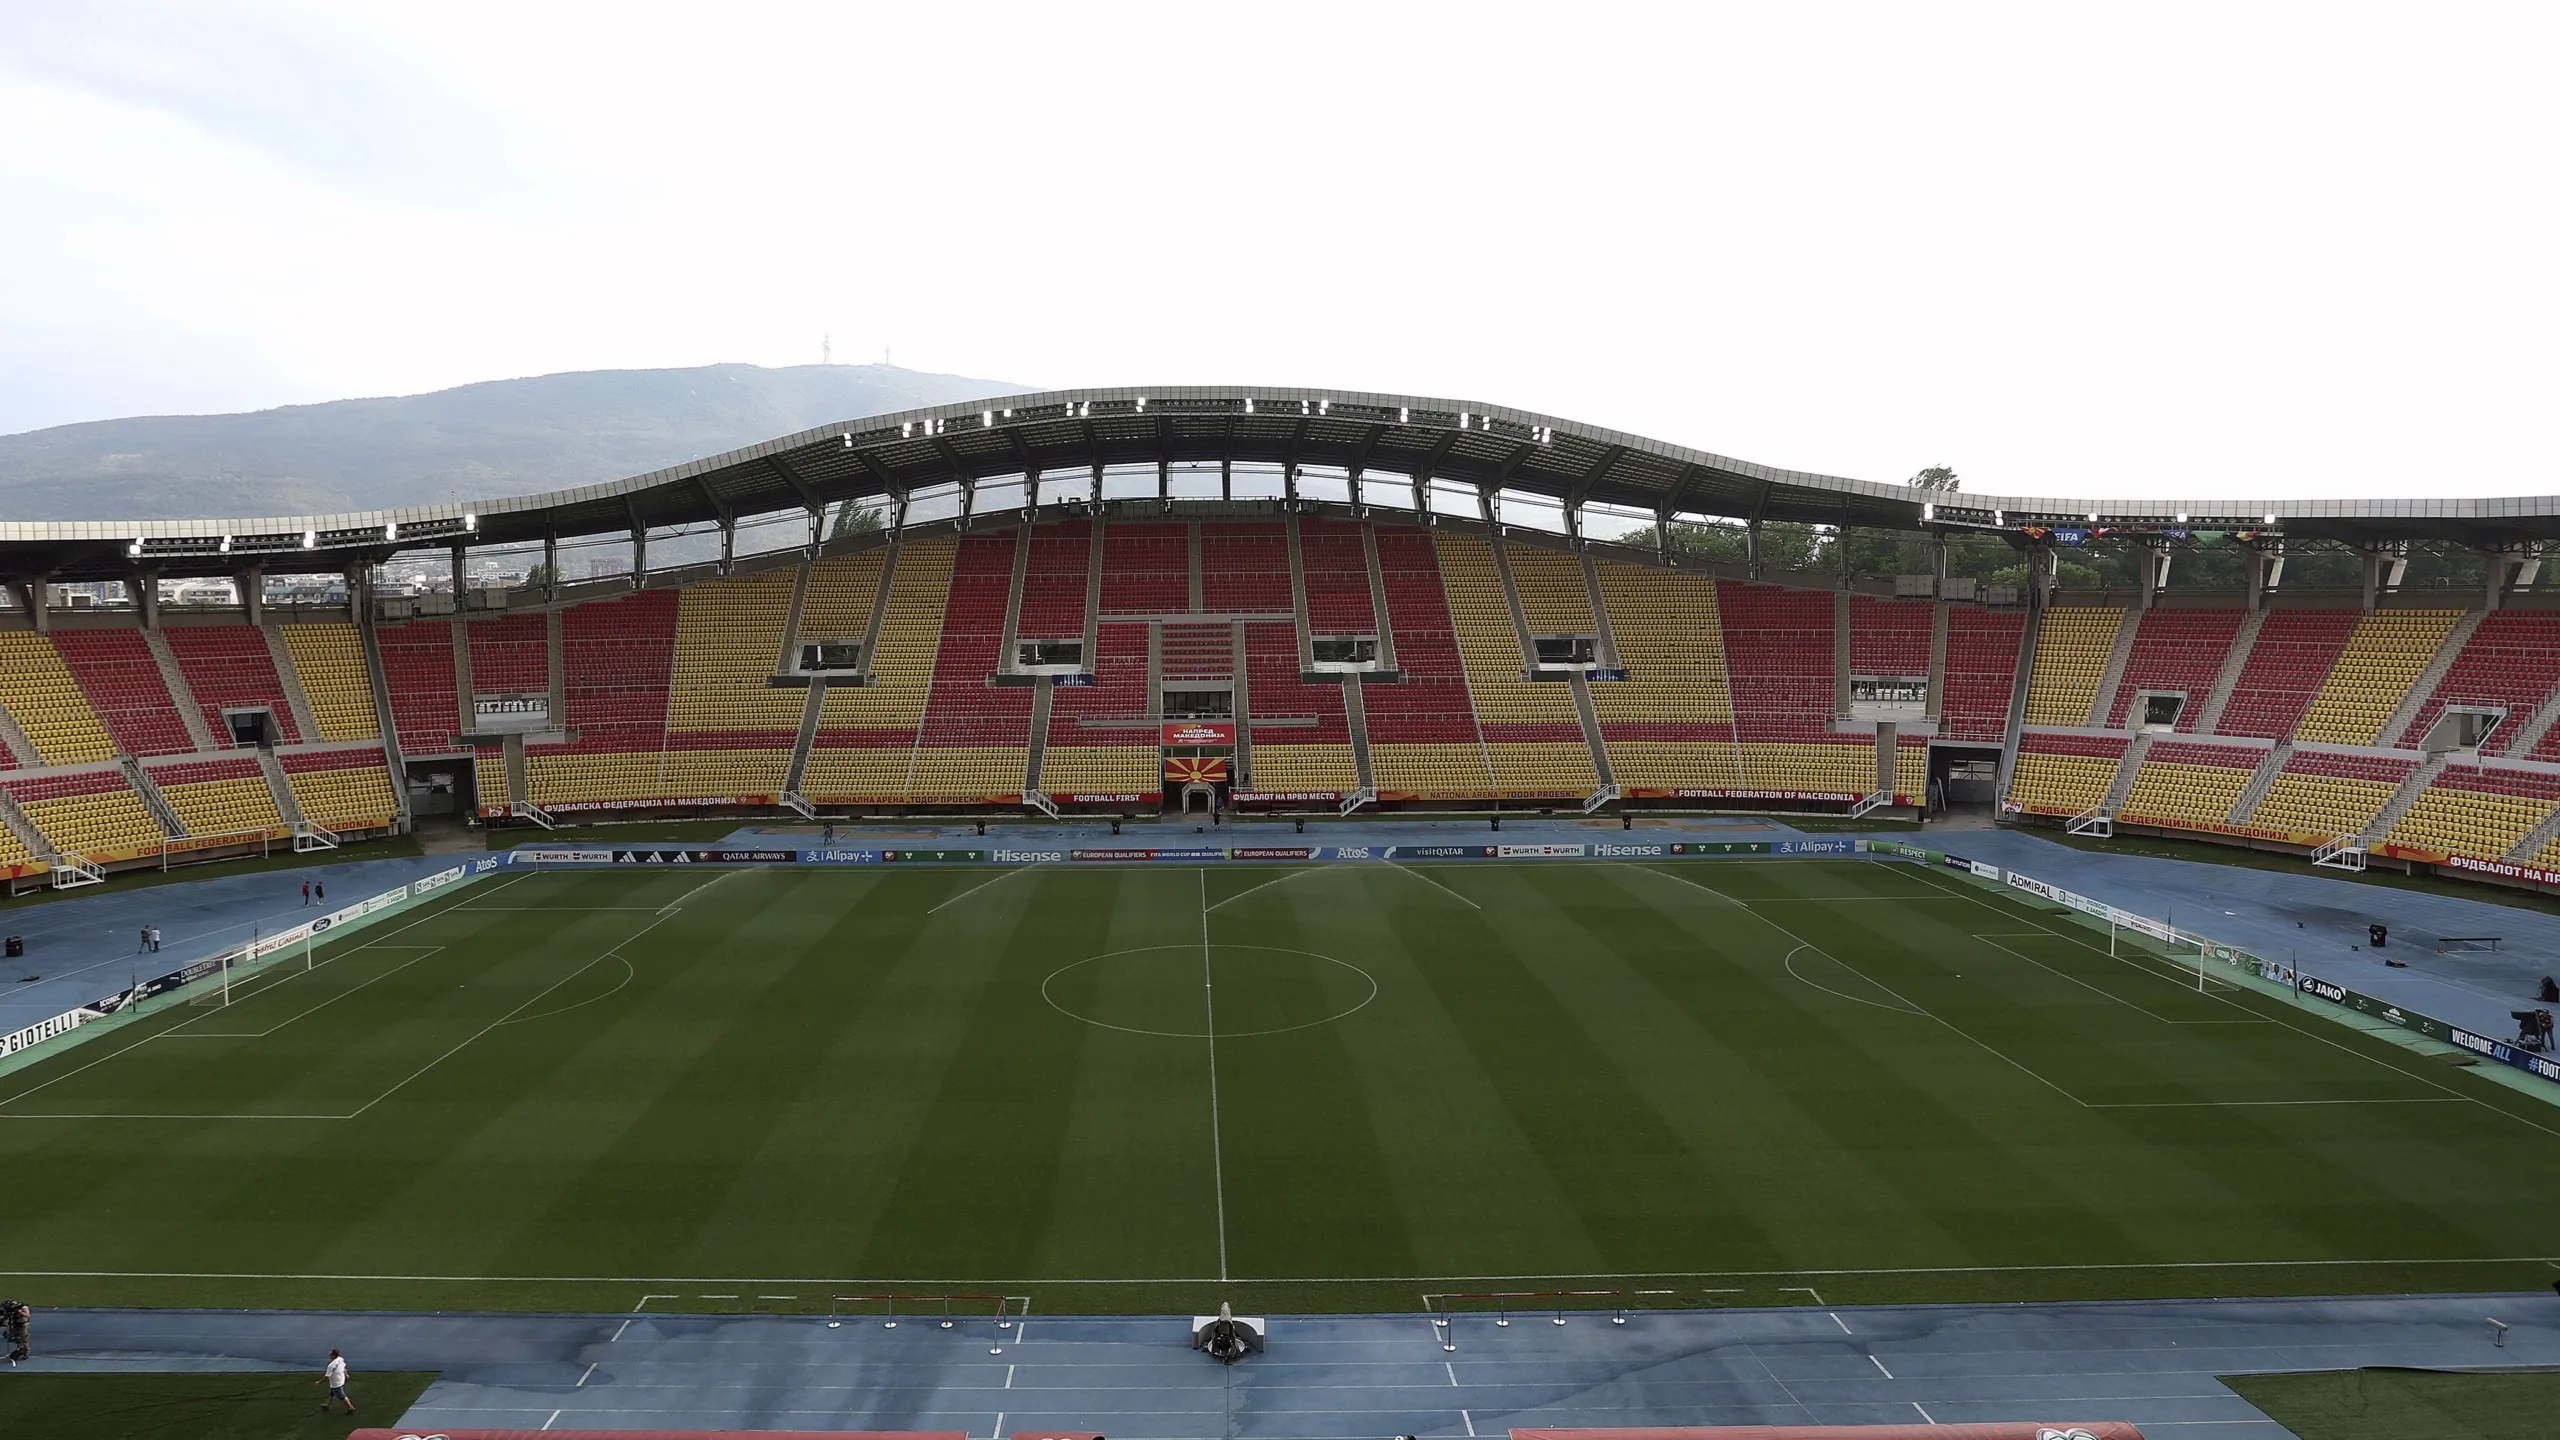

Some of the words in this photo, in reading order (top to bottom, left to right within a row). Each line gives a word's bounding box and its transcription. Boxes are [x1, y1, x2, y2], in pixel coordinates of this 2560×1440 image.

[2055, 532, 2078, 541] FIFA
[816, 796, 876, 804] НАЦИОНАЛНА
[877, 796, 904, 804] АРЕНА
[1116, 794, 1140, 802] FIRST
[1233, 793, 1273, 802] ФУДБАЛОТ
[1275, 792, 1286, 800] НА
[1287, 792, 1307, 801] ПРВО
[1309, 792, 1335, 800] МЕСТО
[1430, 791, 1472, 799] NATIONAL
[1473, 791, 1498, 799] ARENA
[1679, 789, 1723, 798] FOOTBALL
[1725, 790, 1782, 799] FEDERATION
[1784, 791, 1796, 799] OF
[1798, 791, 1854, 801] MACEDONIA
[544, 803, 601, 813] ФУДБАЛСКА
[602, 799, 662, 810] ФЕДЕРАЦИЈА
[664, 799, 676, 807] НА
[678, 797, 736, 806] МАКЕДОНИЈА
[2121, 814, 2192, 829] ФЕДЕРАЦИЈА
[2196, 823, 2209, 831] НА
[2213, 824, 2289, 841] МАКЕДОНИЈА
[137, 841, 193, 857] FOOTBALL
[195, 832, 263, 849] FEDERATION
[266, 830, 278, 839] OF
[723, 852, 750, 860] QATAR
[752, 852, 786, 860] AIRWAYS
[993, 850, 1062, 862] Hisense
[1593, 844, 1662, 856] Hisense
[1900, 848, 1926, 859] RESPECT
[2450, 856, 2521, 877] ФУДБАЛОТ
[2524, 868, 2542, 881] НА
[2010, 874, 2054, 899] ADMIRAL
[2315, 982, 2342, 1001] JAKO
[10, 1012, 73, 1052] GIOTELLI
[2452, 1028, 2493, 1056] WELCOME
[2493, 1044, 2511, 1061] ALL
[2528, 1057, 2560, 1081] #FOOT
